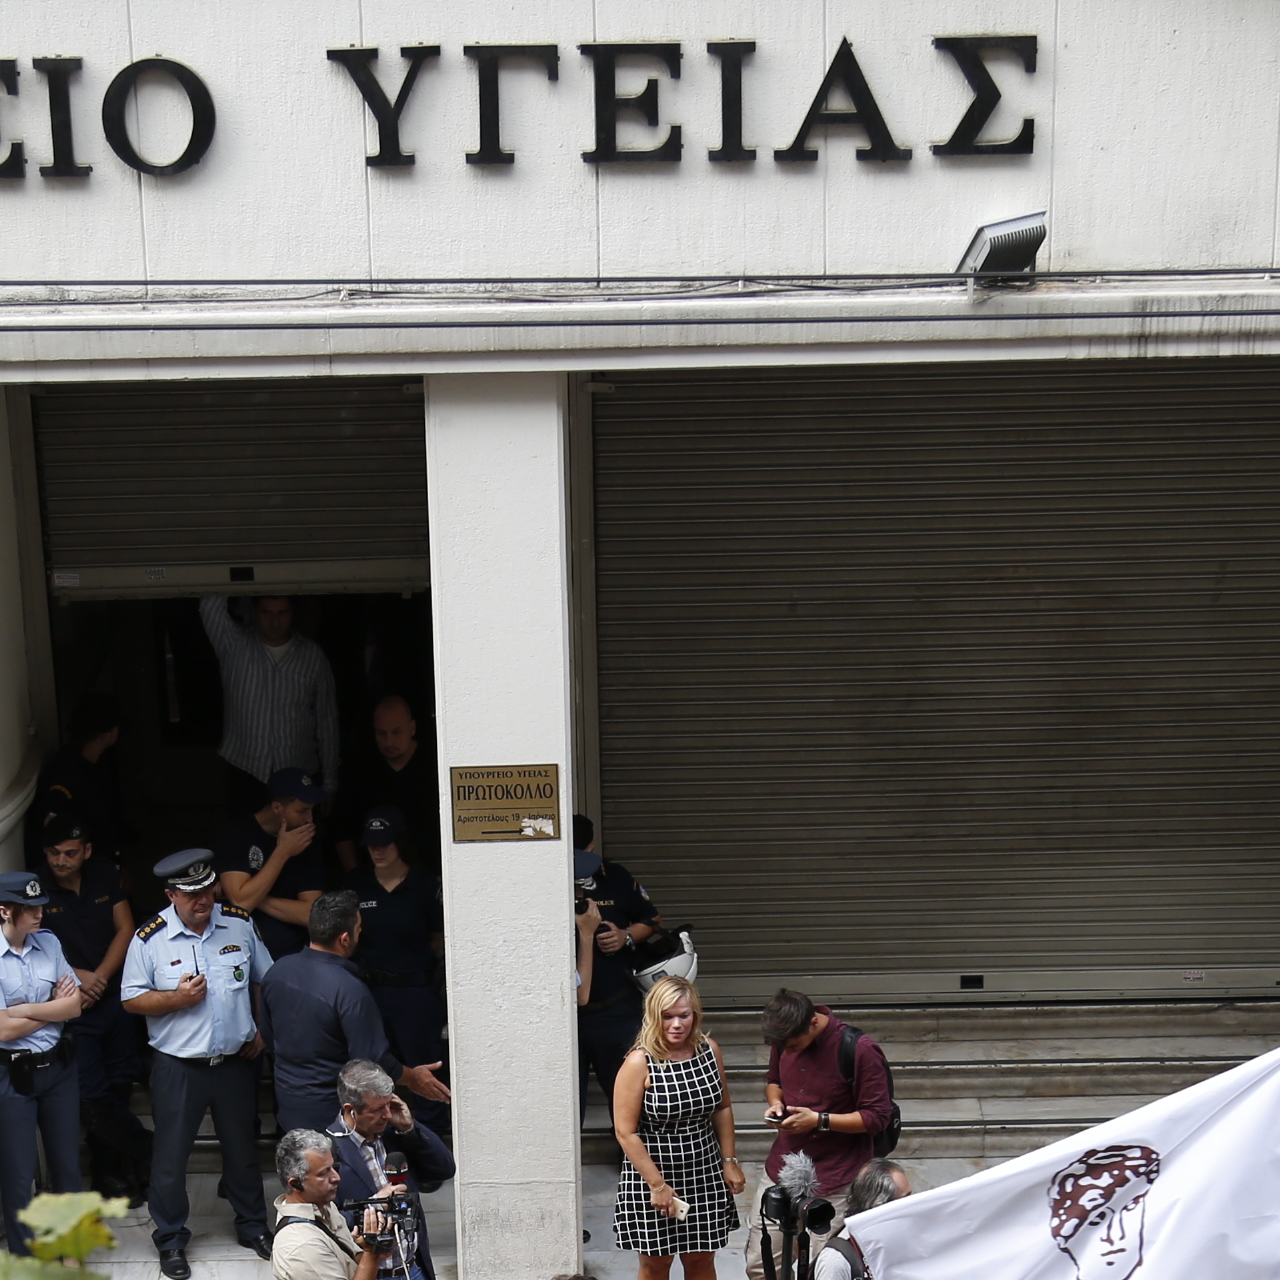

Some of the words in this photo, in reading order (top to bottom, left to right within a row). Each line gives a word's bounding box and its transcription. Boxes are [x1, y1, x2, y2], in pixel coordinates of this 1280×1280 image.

[327, 34, 1038, 167] ΥΓΕΙΑΣ
[458, 770, 514, 780] ΥΠΟΥΡΓΕΙΟ
[517, 770, 550, 778] ΥΓΕΙΑΣ
[456, 783, 554, 801] ΠΡΩΤΟΚΟΛΛΟ
[457, 813, 509, 823] Αριστοτέλους
[511, 812, 520, 822] 19
